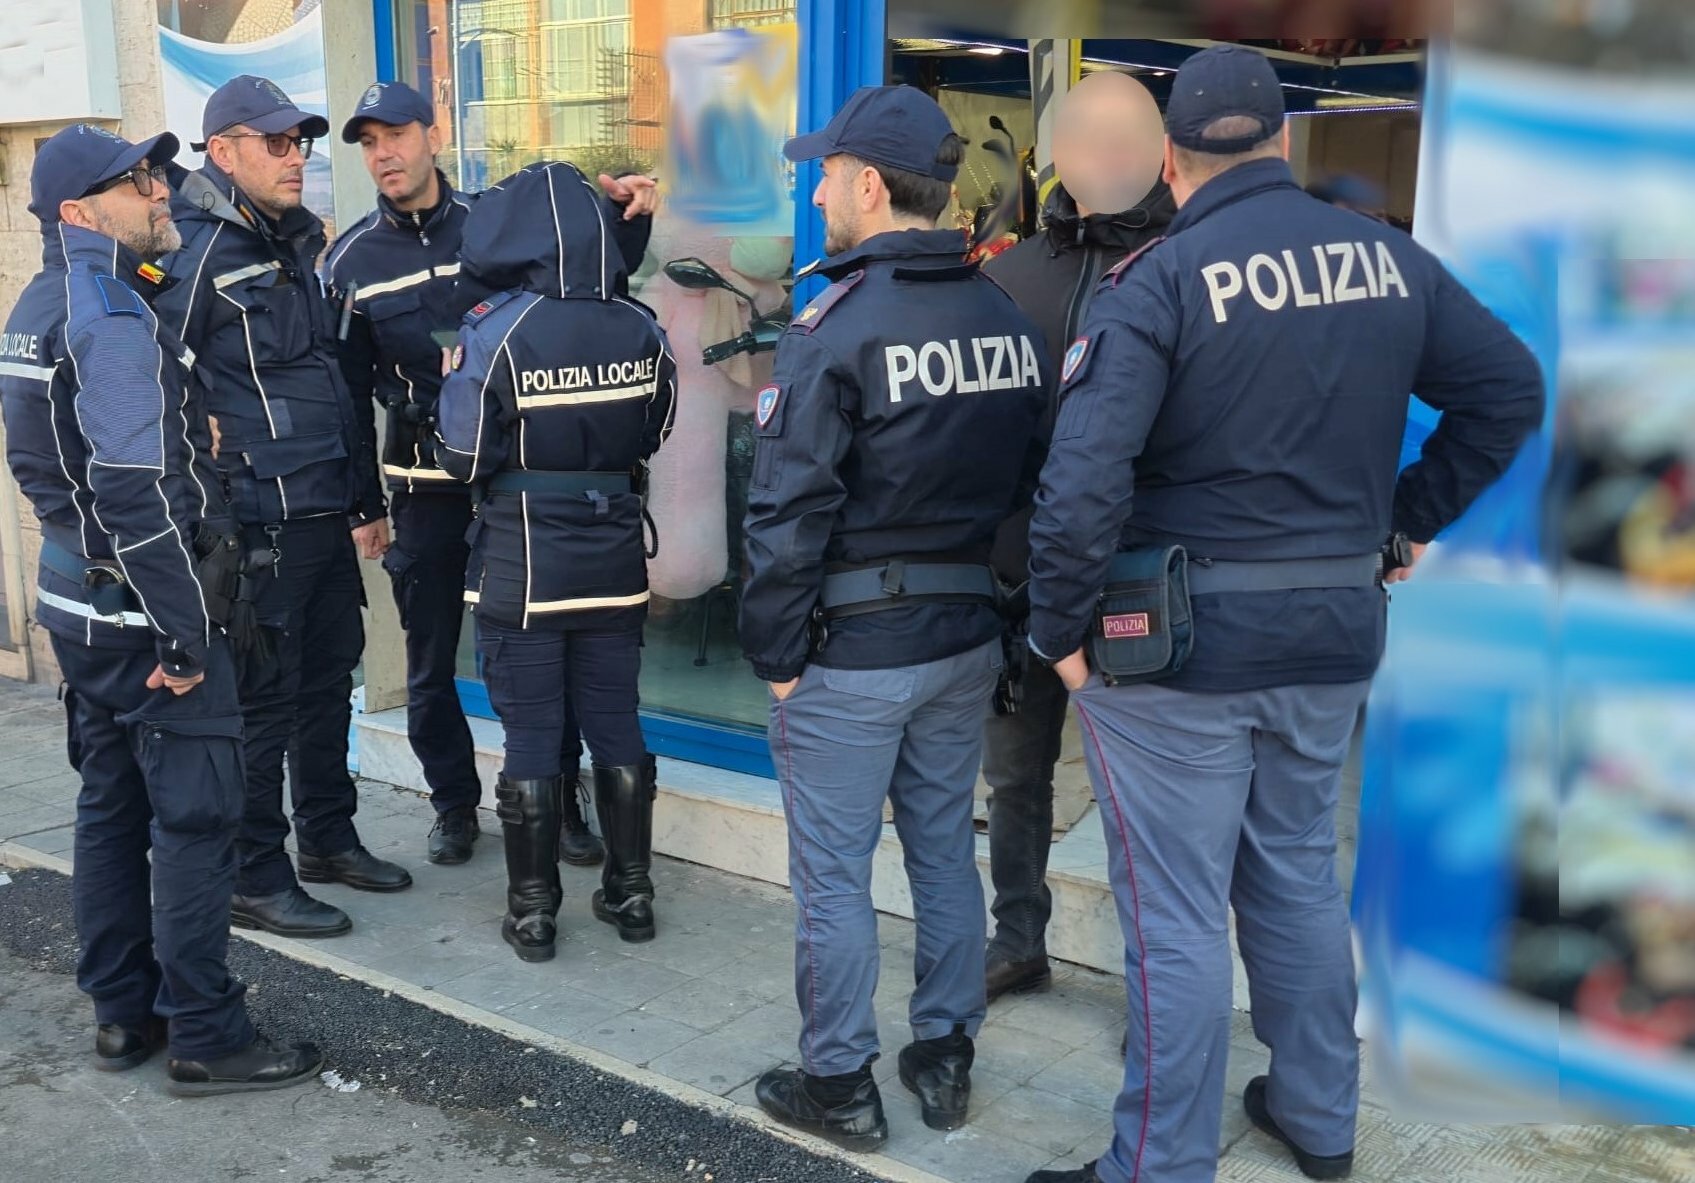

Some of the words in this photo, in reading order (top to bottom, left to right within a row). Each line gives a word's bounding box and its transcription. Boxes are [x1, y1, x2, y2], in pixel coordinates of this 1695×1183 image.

[1200, 240, 1409, 323] POLIZIA
[521, 365, 593, 393] POLIZIA
[597, 357, 654, 385] LOCALE
[884, 335, 1042, 403] POLIZIA
[1106, 619, 1145, 633] POLIZIA
